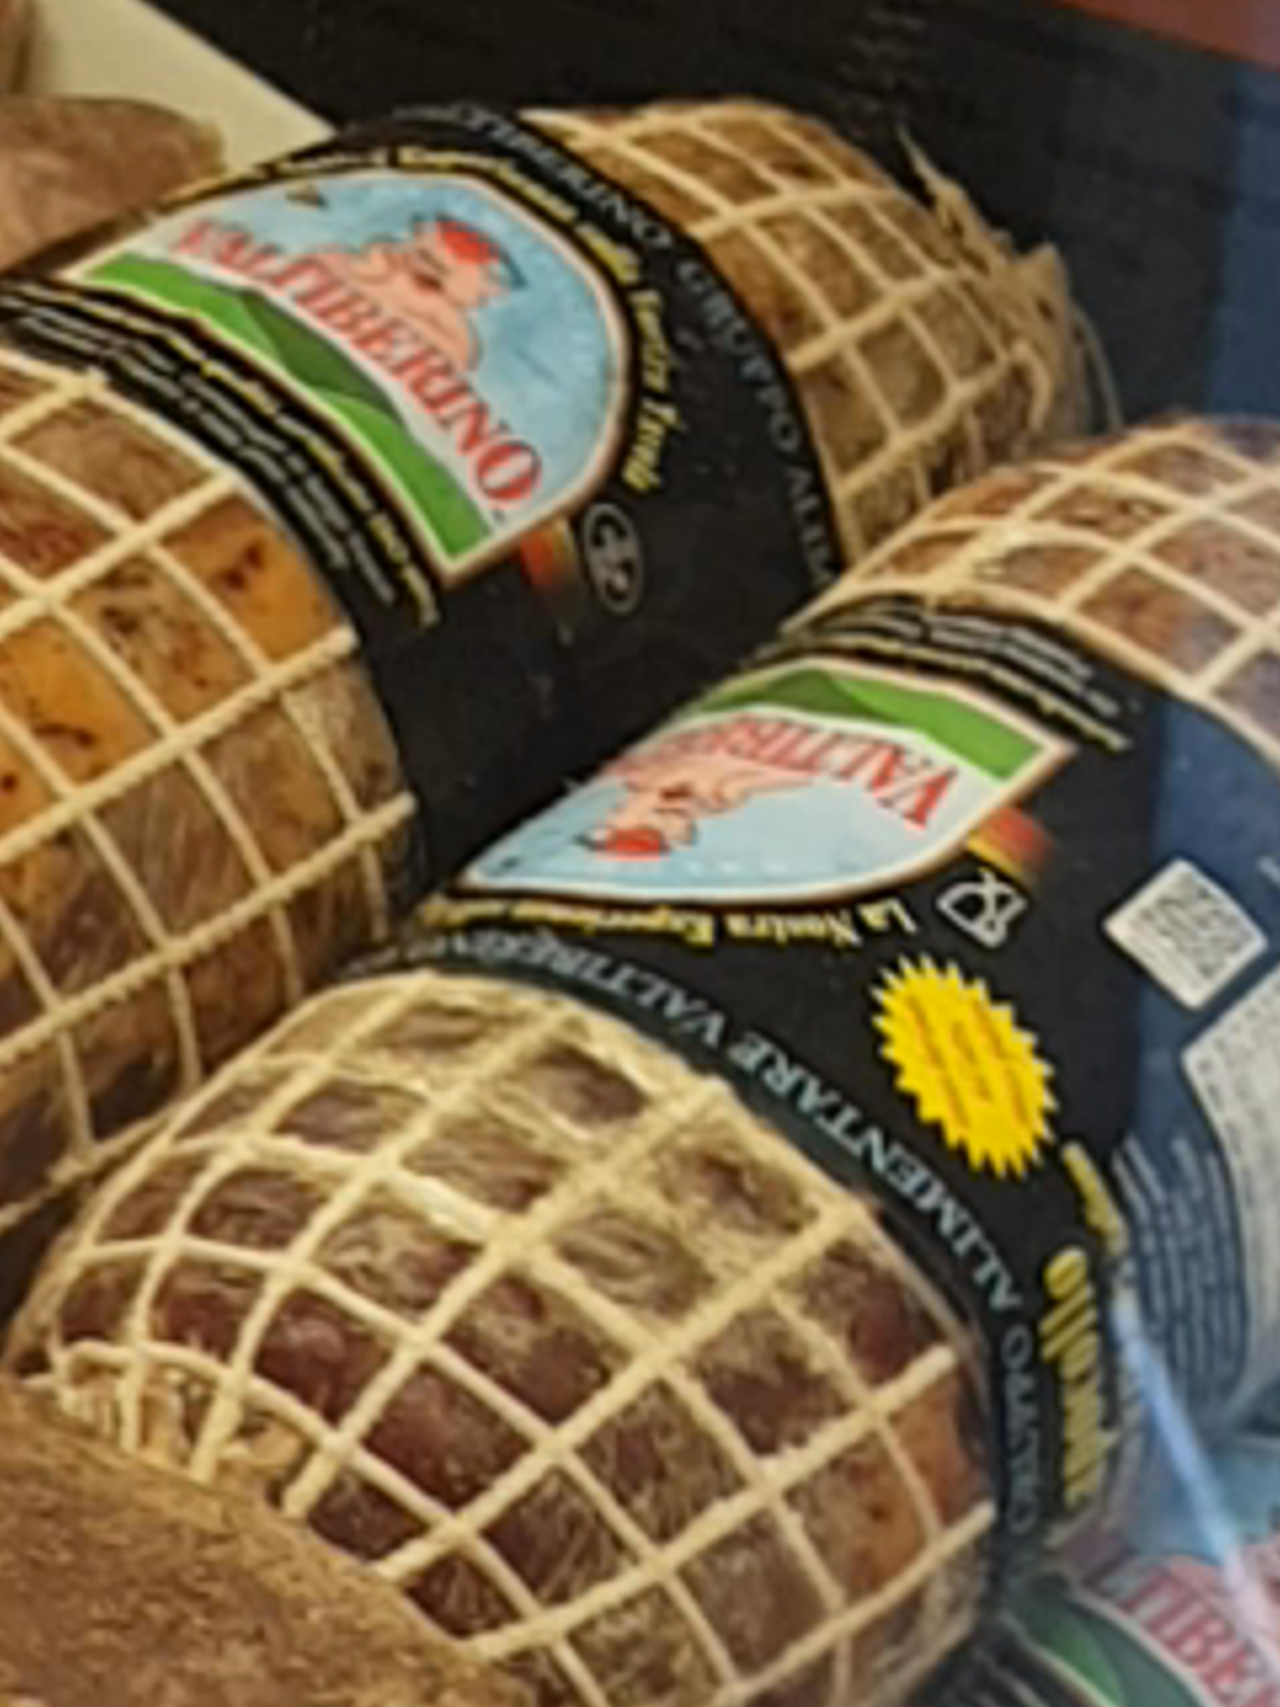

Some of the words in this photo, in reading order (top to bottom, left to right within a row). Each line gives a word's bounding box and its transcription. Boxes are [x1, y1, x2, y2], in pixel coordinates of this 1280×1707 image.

[170, 218, 544, 507] VALTIBERINO
[858, 895, 918, 935] La
[728, 1027, 1020, 1315] ALIMENTARE
